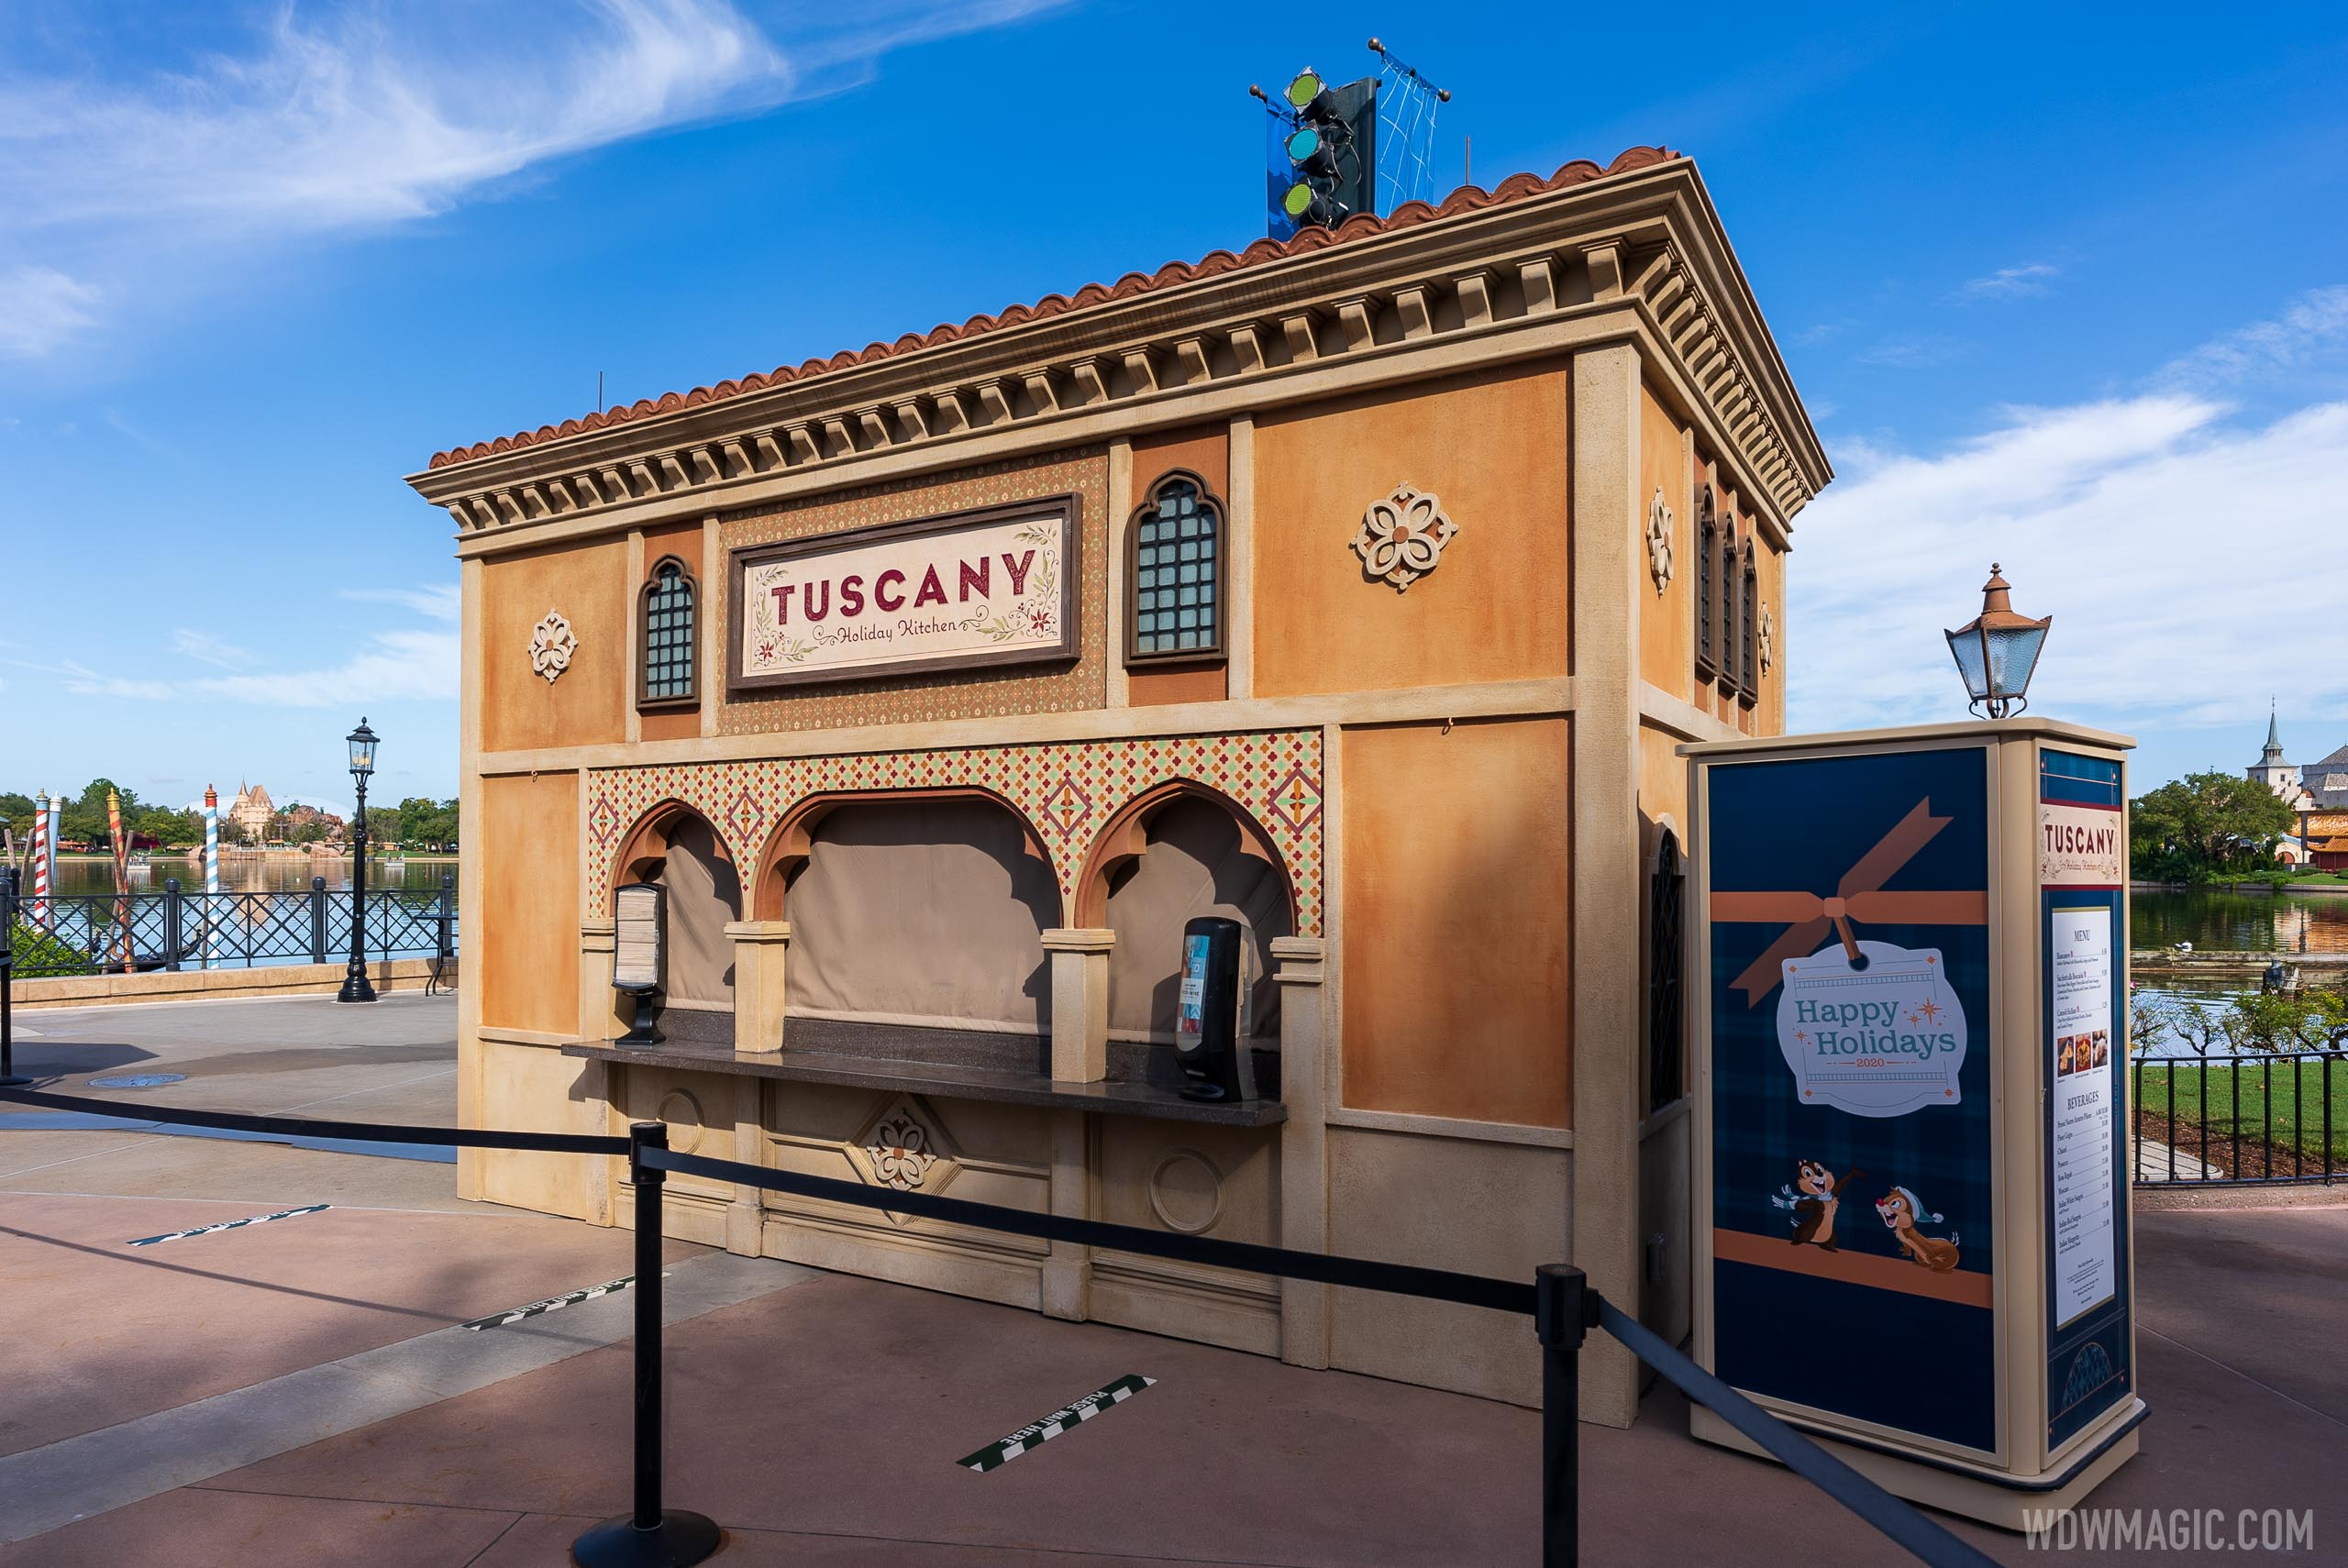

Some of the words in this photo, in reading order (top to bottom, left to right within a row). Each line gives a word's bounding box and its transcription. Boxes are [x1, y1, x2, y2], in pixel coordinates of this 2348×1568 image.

[770, 548, 1036, 626] TUSCANY
[836, 623, 893, 644] Holiday
[897, 615, 958, 637] Kitchen
[2044, 823, 2115, 856] TUSCANY
[2073, 929, 2091, 943] MENU
[1793, 999, 1900, 1028] Happy
[1813, 1029, 1957, 1061] Holidays
[1855, 1057, 1886, 1068] 2020
[2066, 1090, 2100, 1110] BEVERAGES
[1066, 1390, 1110, 1412] PLEASE
[1038, 1408, 1074, 1427] WAIT
[999, 1424, 1044, 1446] HERE
